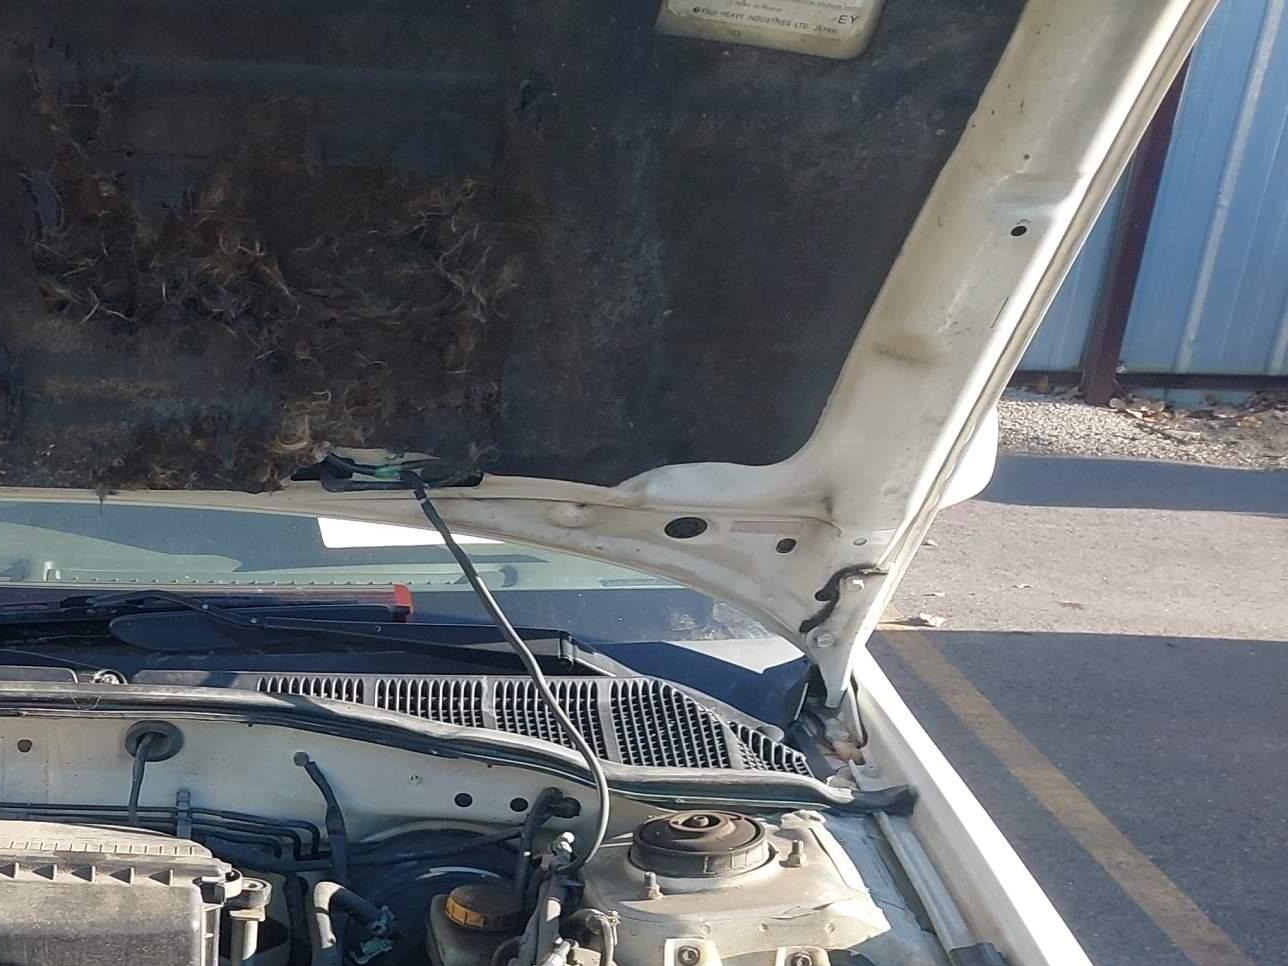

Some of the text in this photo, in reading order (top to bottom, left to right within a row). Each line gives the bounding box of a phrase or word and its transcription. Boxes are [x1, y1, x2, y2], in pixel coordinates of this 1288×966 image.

[720, 11, 744, 20] HEAVY
[747, 14, 791, 27] INDUSTRIES
[837, 14, 860, 25] EY
